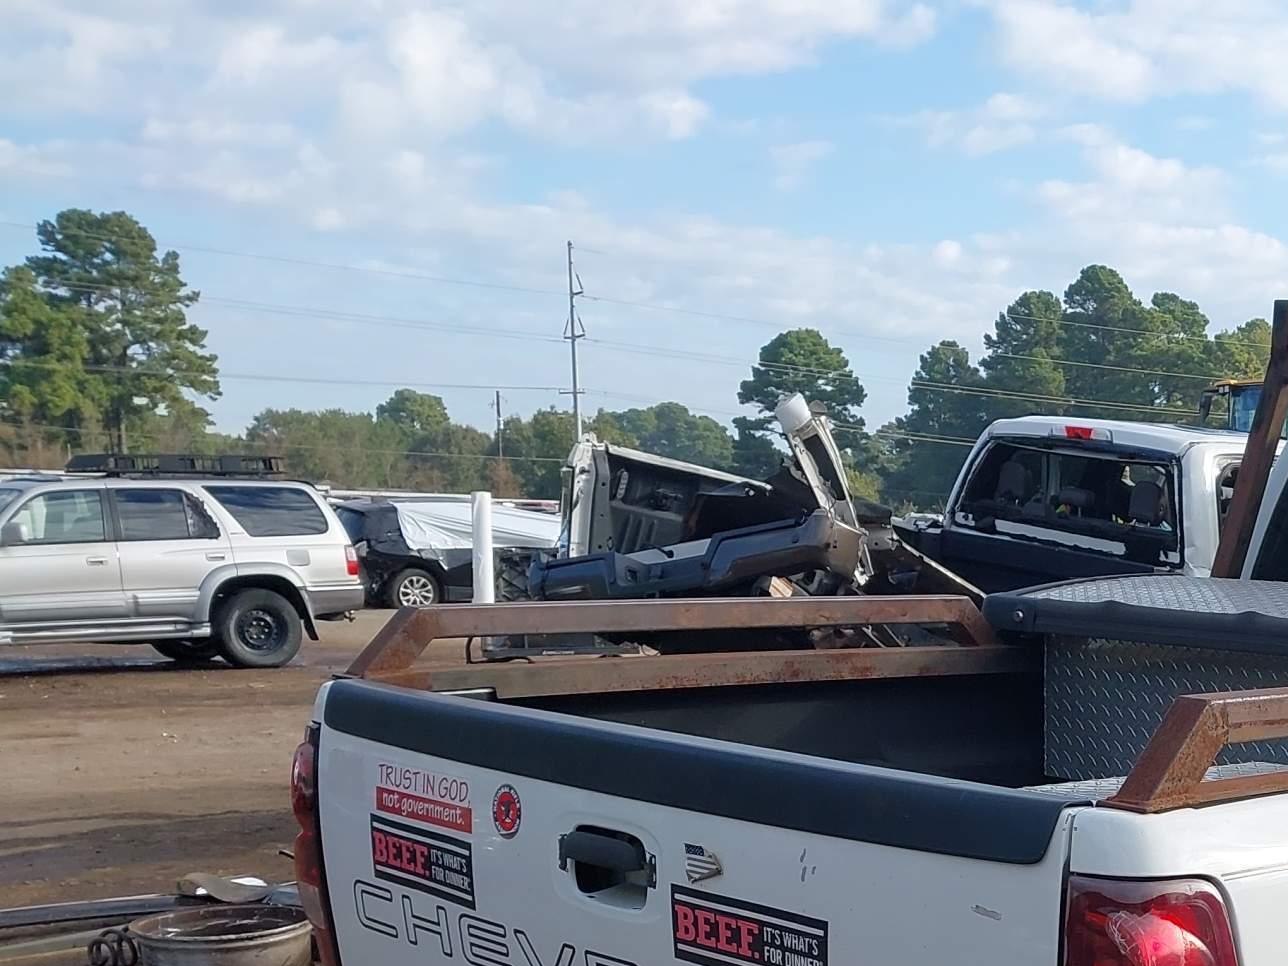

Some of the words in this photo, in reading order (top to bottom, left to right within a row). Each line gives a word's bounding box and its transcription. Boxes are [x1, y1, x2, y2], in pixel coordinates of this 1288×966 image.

[378, 763, 421, 790] TRUST
[422, 772, 435, 795] IN
[438, 777, 471, 807] GOD,
[382, 791, 400, 808] not
[401, 796, 465, 825] government.
[372, 830, 431, 877] BEEF.
[430, 848, 443, 865] IT'S
[443, 851, 467, 873] WHAT'S
[431, 865, 445, 881] FOR
[674, 904, 760, 959] BEEF.
[763, 926, 781, 945] IT'S
[781, 931, 819, 956] WHAT'S
[763, 946, 783, 966] FOR
